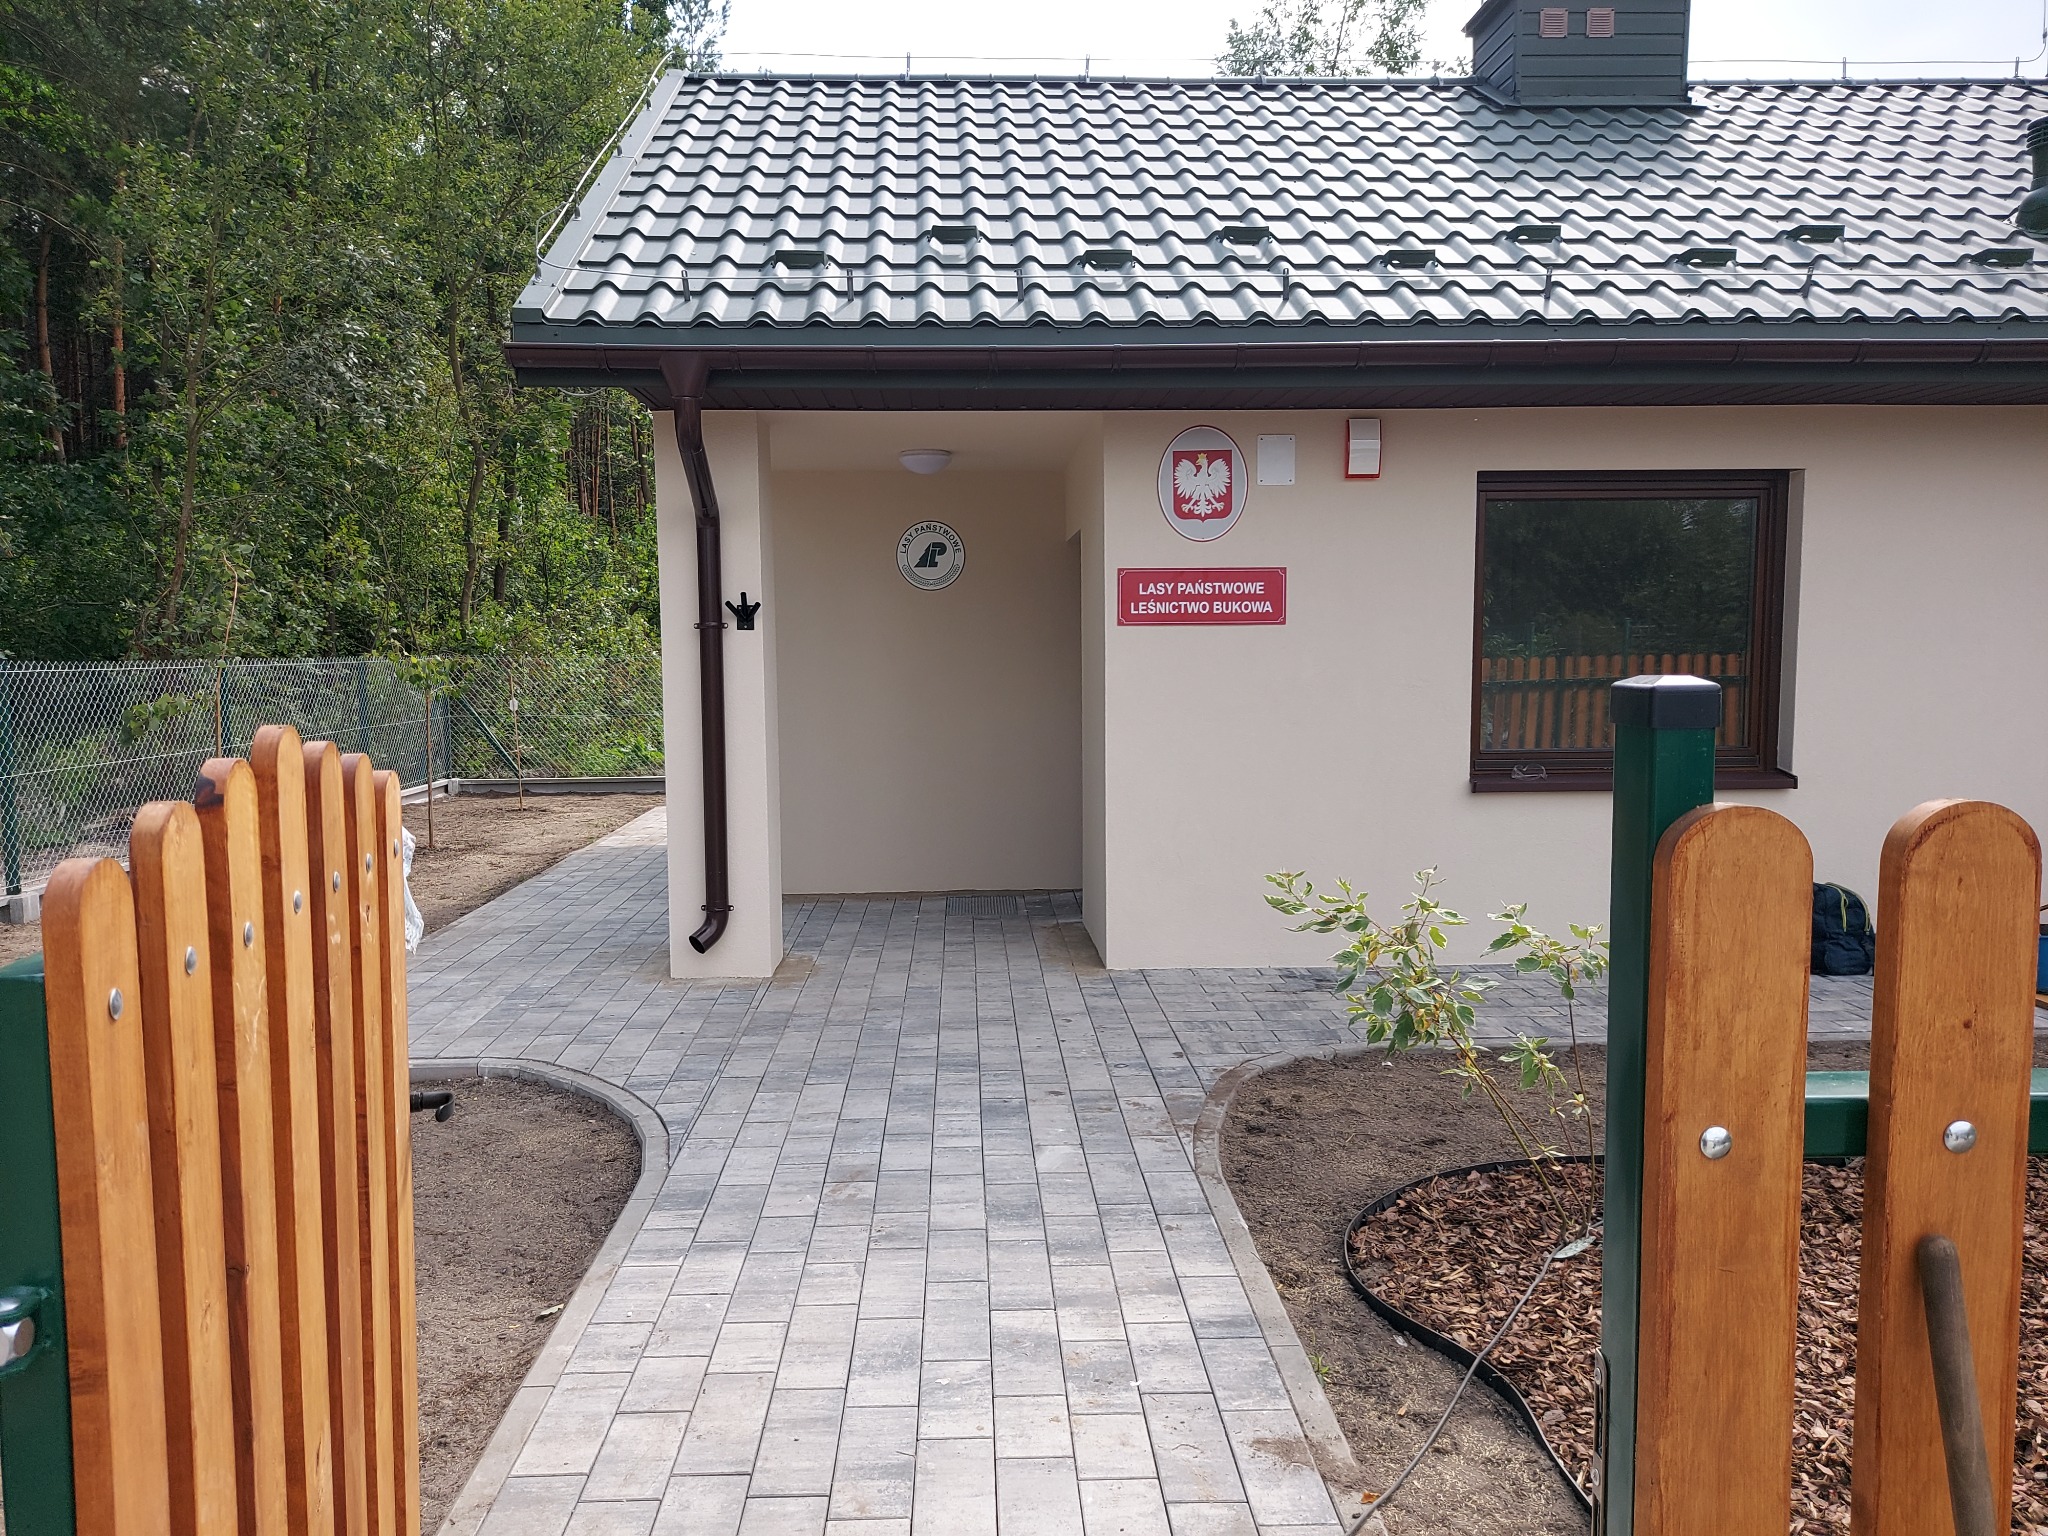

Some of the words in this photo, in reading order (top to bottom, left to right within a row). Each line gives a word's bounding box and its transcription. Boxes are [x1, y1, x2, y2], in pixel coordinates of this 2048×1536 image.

[900, 532, 914, 554] LASY
[914, 523, 962, 554] PAŃSTWOWE
[1139, 582, 1175, 595] LASY
[1177, 579, 1265, 595] PAŃSTWOWE
[1130, 598, 1210, 614] LEŚNICTWO
[1213, 601, 1273, 614] BUKOWA
